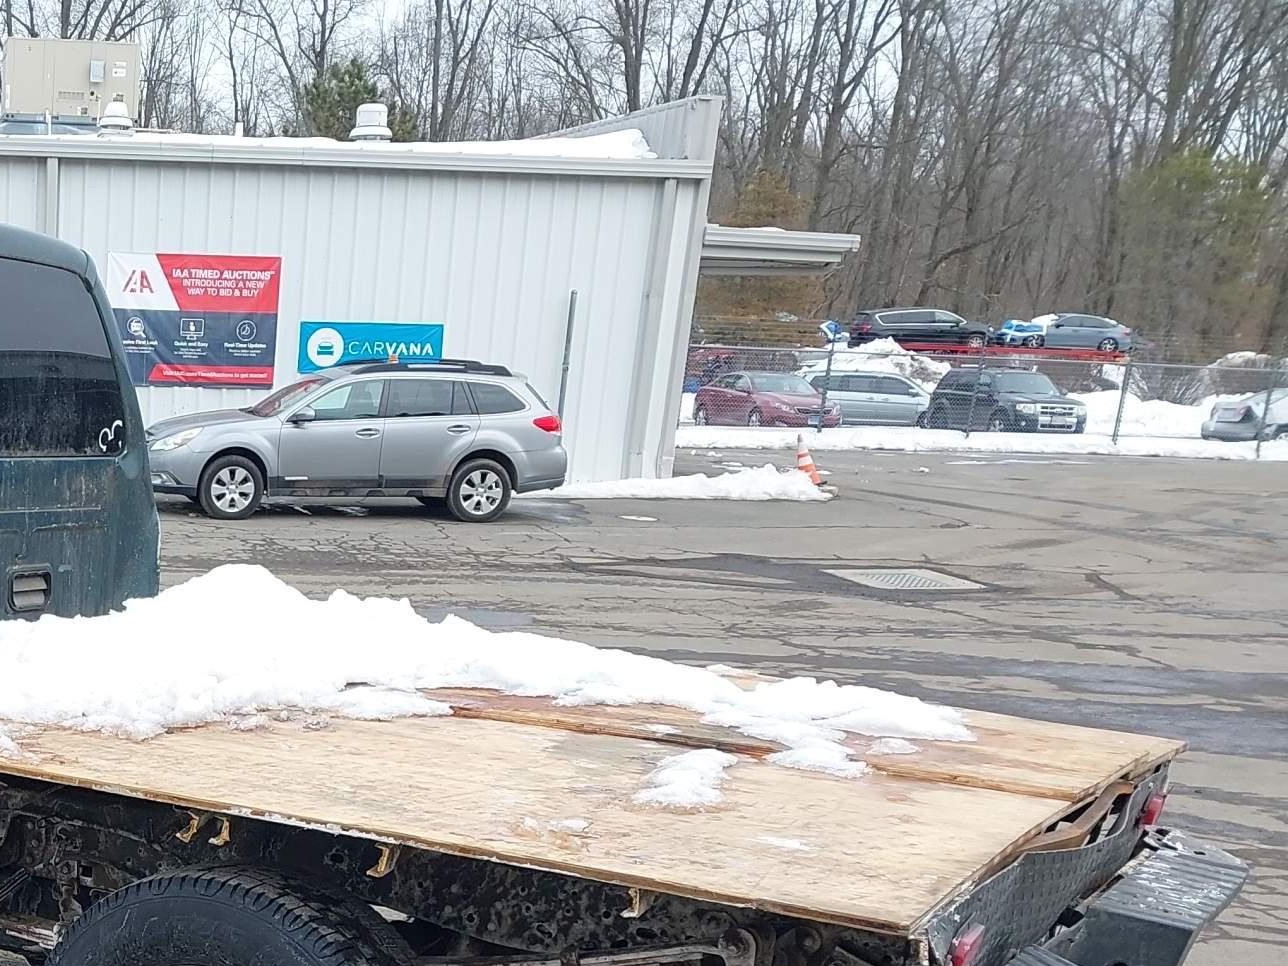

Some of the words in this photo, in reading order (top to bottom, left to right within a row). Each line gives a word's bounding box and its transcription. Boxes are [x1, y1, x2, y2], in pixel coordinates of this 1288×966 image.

[172, 269, 189, 278] IAA
[190, 269, 220, 279] TIMED
[183, 279, 236, 289] INTRODUCING
[238, 280, 244, 288] A
[246, 281, 265, 289] NEW
[187, 288, 205, 296] WAY
[207, 288, 217, 296] TO
[219, 288, 232, 297] BID
[234, 288, 240, 297] &
[242, 288, 259, 298] BUY
[348, 341, 434, 357] CARVANA
